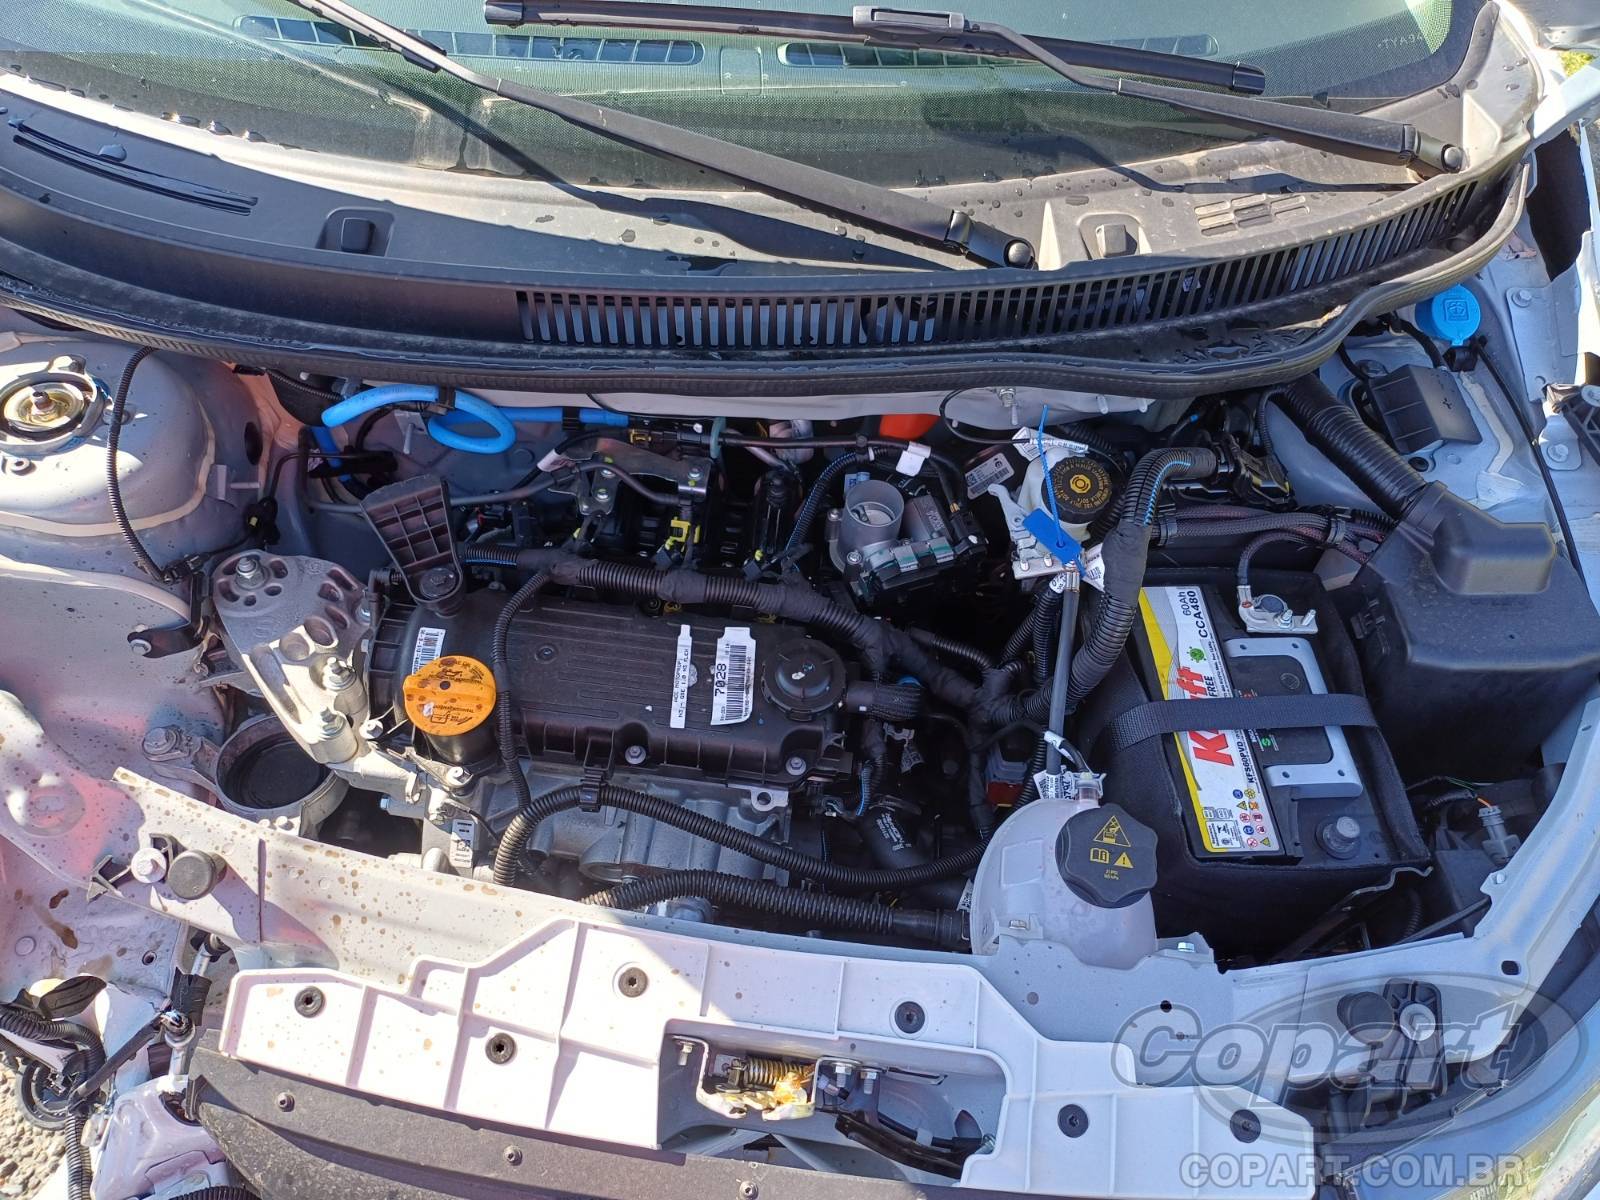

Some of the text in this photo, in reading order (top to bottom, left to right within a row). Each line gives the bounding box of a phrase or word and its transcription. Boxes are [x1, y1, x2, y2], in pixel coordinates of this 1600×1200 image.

[1178, 590, 1192, 617] 60Ah
[1186, 590, 1208, 639] CCA480
[714, 663, 727, 697] 7028
[1205, 674, 1218, 698] FREE
